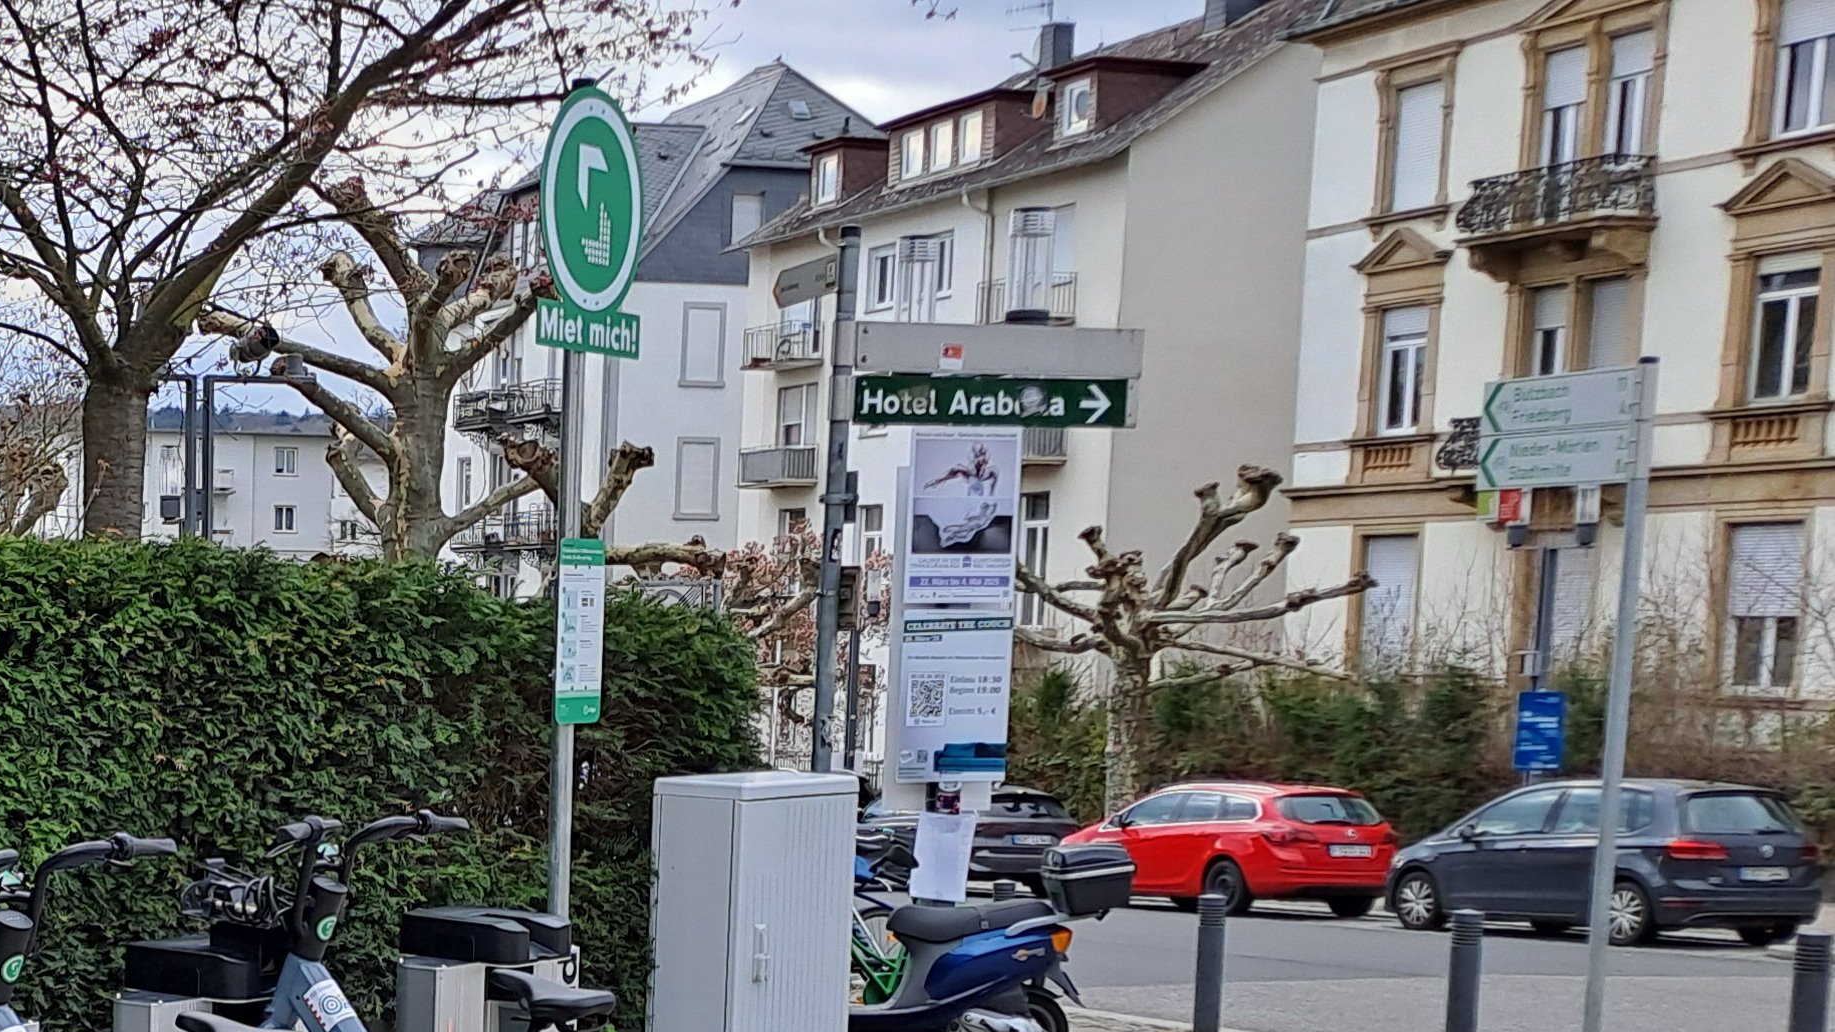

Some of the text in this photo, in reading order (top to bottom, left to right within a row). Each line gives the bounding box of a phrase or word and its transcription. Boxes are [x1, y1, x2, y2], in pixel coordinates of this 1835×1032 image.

[540, 305, 637, 353] Miet mich!
[860, 387, 1065, 417] Hotel Araba
